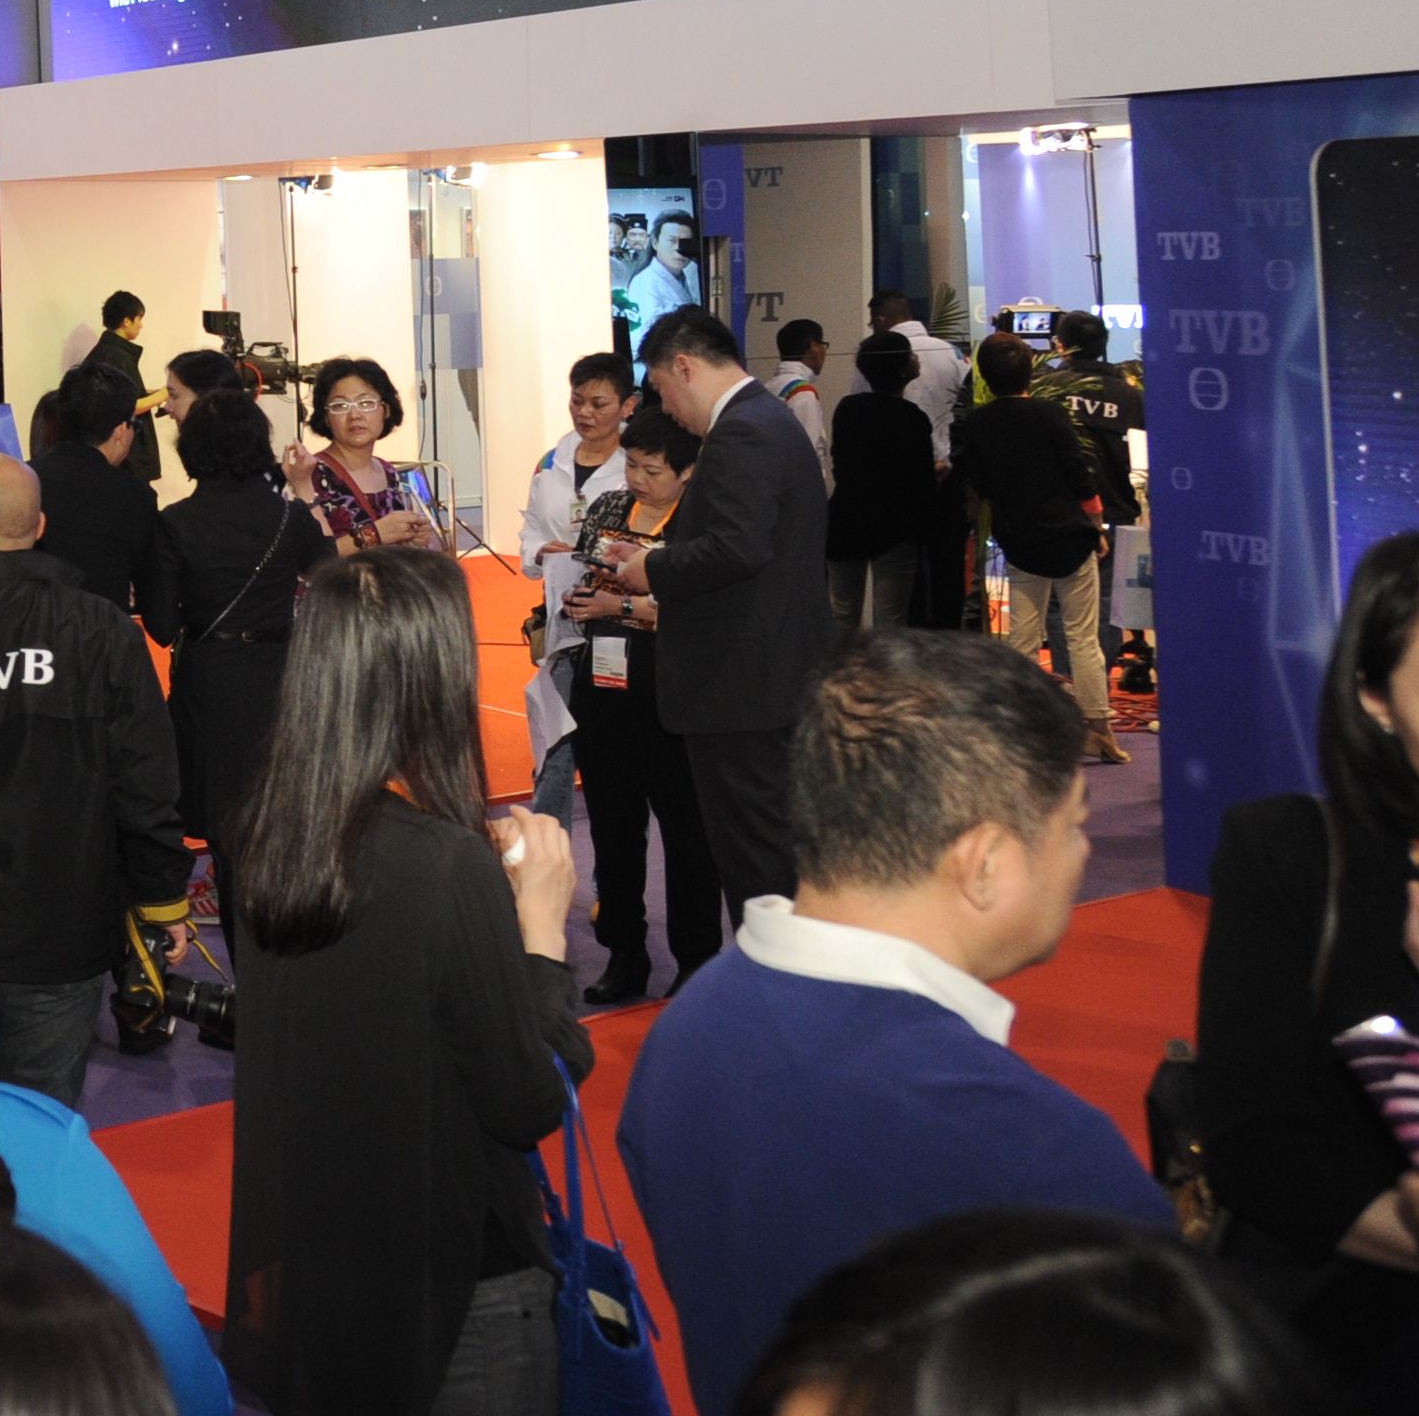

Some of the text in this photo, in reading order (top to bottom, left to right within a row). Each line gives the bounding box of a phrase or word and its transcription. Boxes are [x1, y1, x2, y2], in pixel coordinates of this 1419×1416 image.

[1156, 231, 1221, 262] TVB
[1168, 308, 1271, 356] TVB
[1068, 394, 1120, 419] TVB
[1200, 530, 1271, 566] TVB
